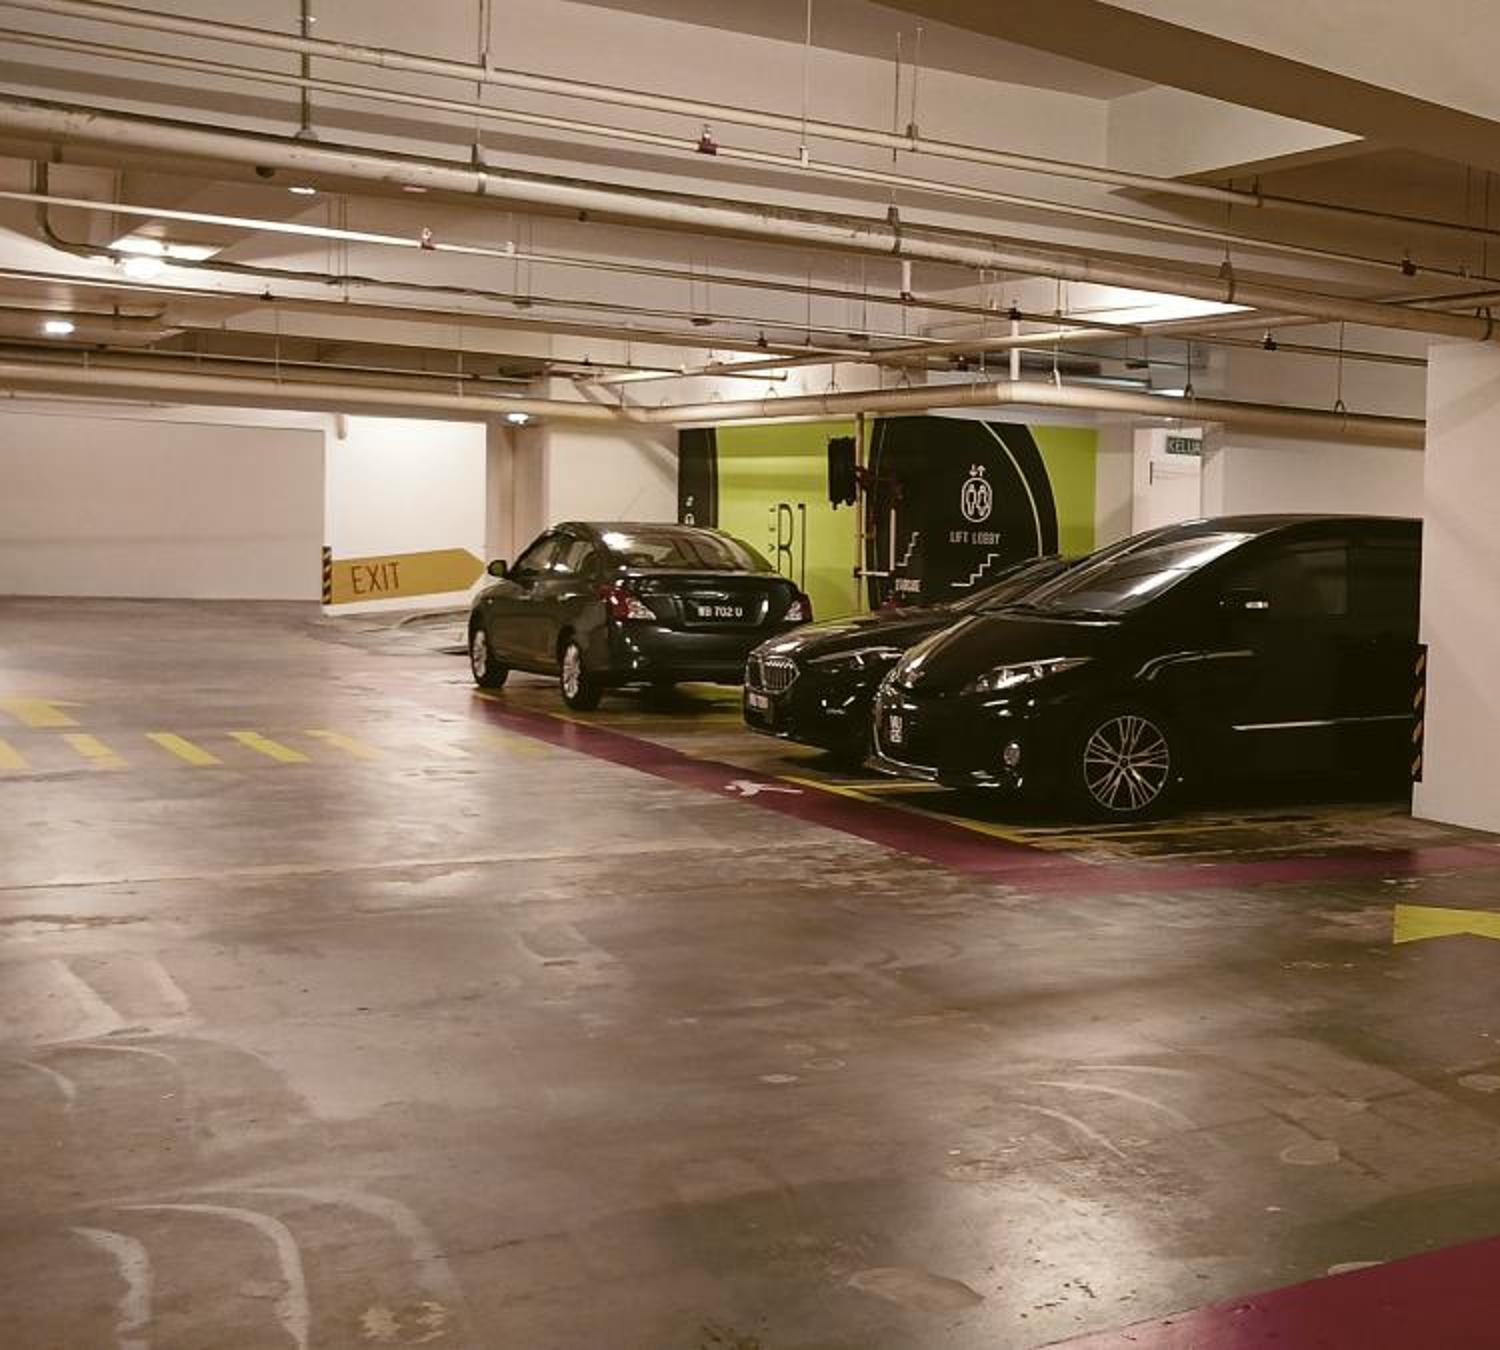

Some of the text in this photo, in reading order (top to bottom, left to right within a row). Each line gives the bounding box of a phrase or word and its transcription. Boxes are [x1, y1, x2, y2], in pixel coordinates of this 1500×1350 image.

[1168, 438, 1202, 452] KELUA
[949, 531, 969, 543] LIFT
[351, 561, 400, 595] EXIT
[714, 606, 734, 617] 702
[735, 607, 743, 617] U
